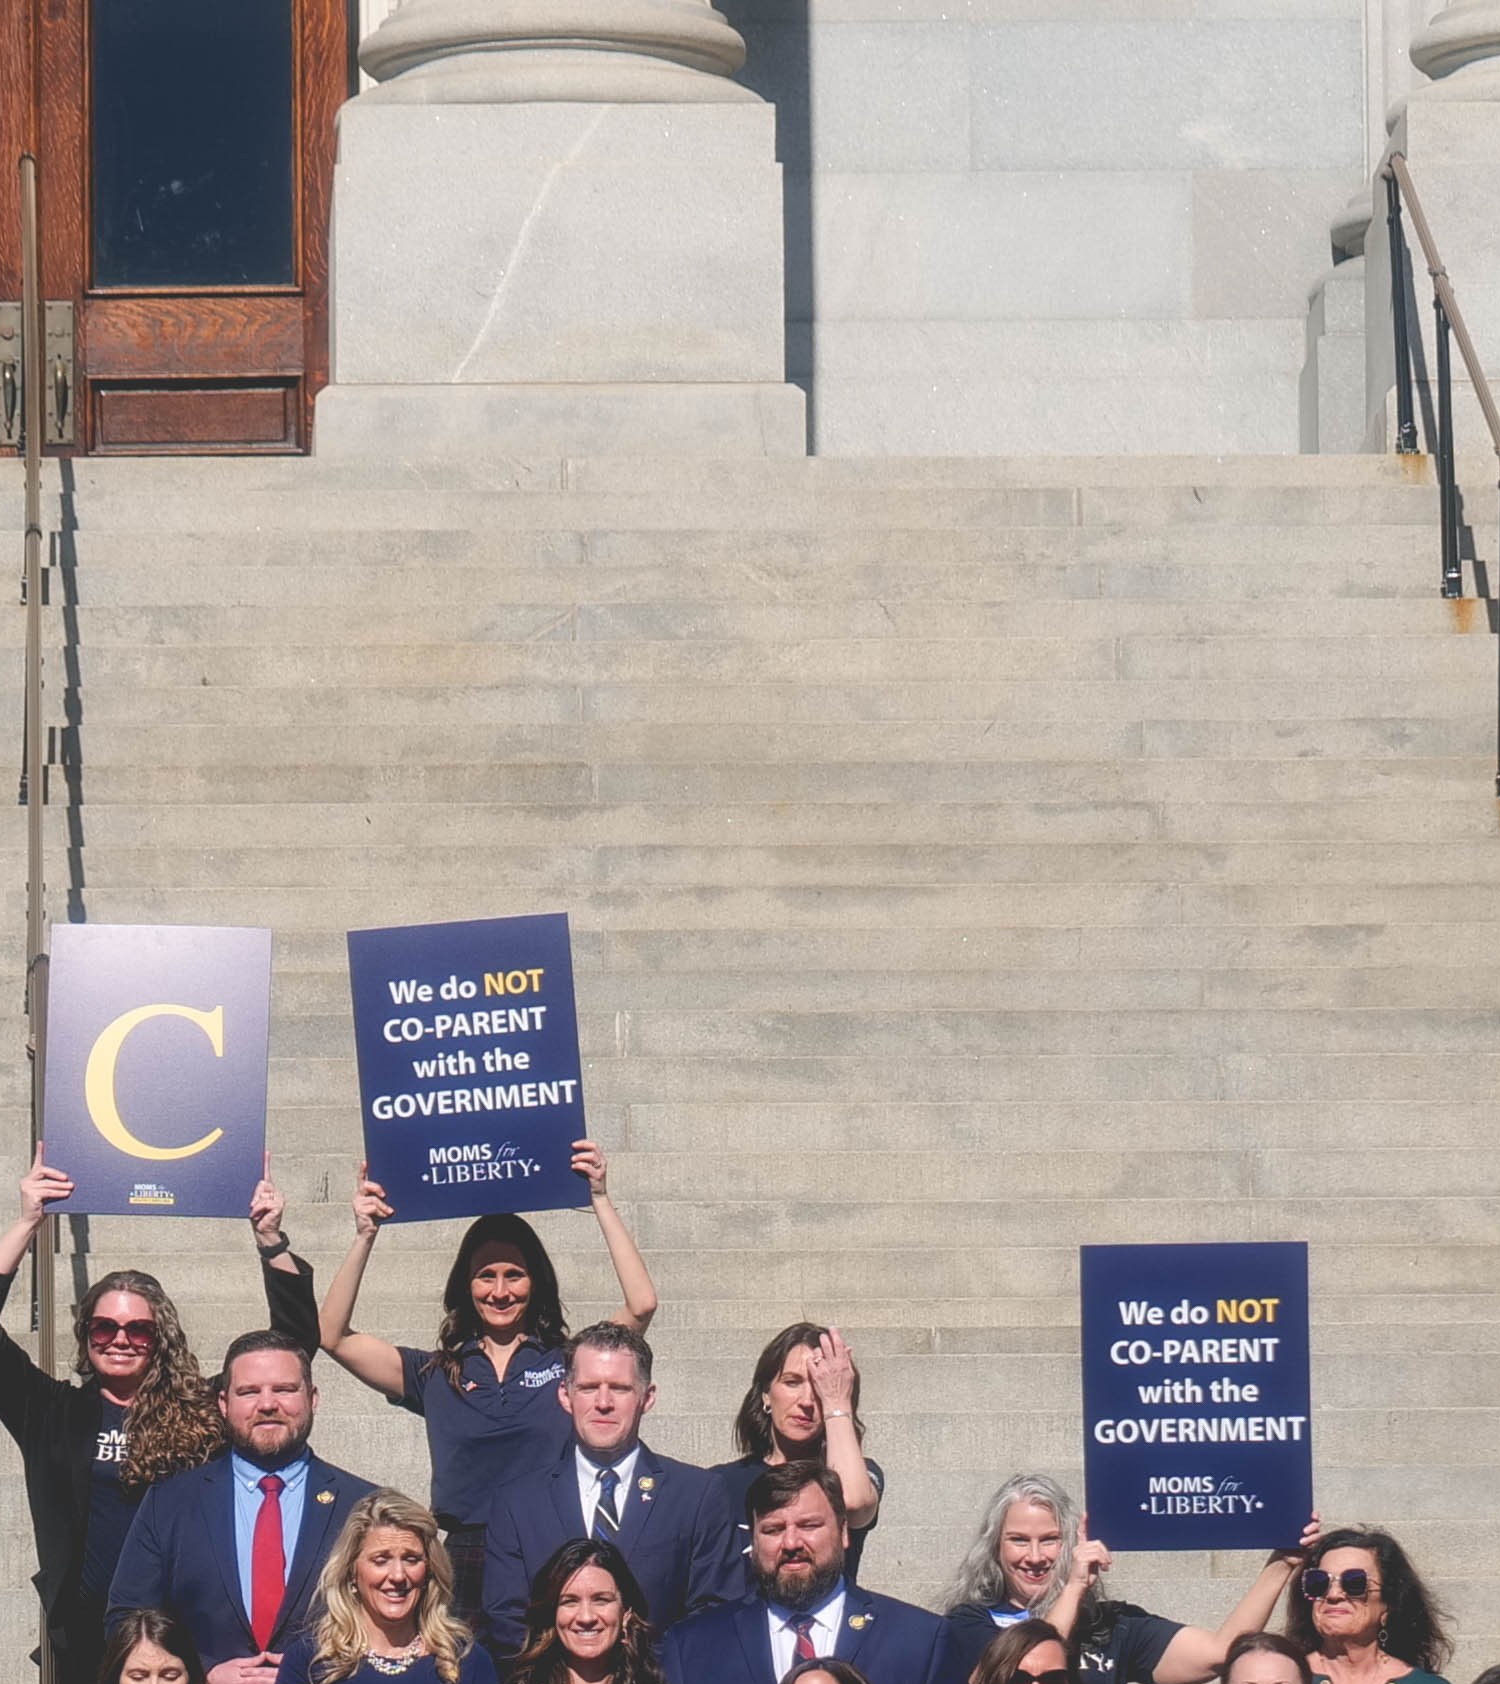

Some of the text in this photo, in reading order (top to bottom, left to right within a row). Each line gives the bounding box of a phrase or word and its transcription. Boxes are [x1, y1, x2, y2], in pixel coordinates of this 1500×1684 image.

[389, 968, 544, 1004] We do NOT
[383, 1006, 547, 1043] CO-PARENT
[413, 1047, 530, 1079] with the
[85, 1003, 224, 1160] C
[372, 1080, 577, 1119] GOVERNMENT
[429, 1141, 520, 1164] MOMS for
[431, 1158, 534, 1185] LIBERTY
[1118, 1298, 1279, 1326] We do NOT
[1110, 1338, 1279, 1365] CO-PARENT
[1138, 1377, 1259, 1404] with the
[1094, 1416, 1306, 1444] GOVERNMENT
[1149, 1475, 1243, 1498] MOMS for
[1150, 1494, 1256, 1515] LIBERTY
